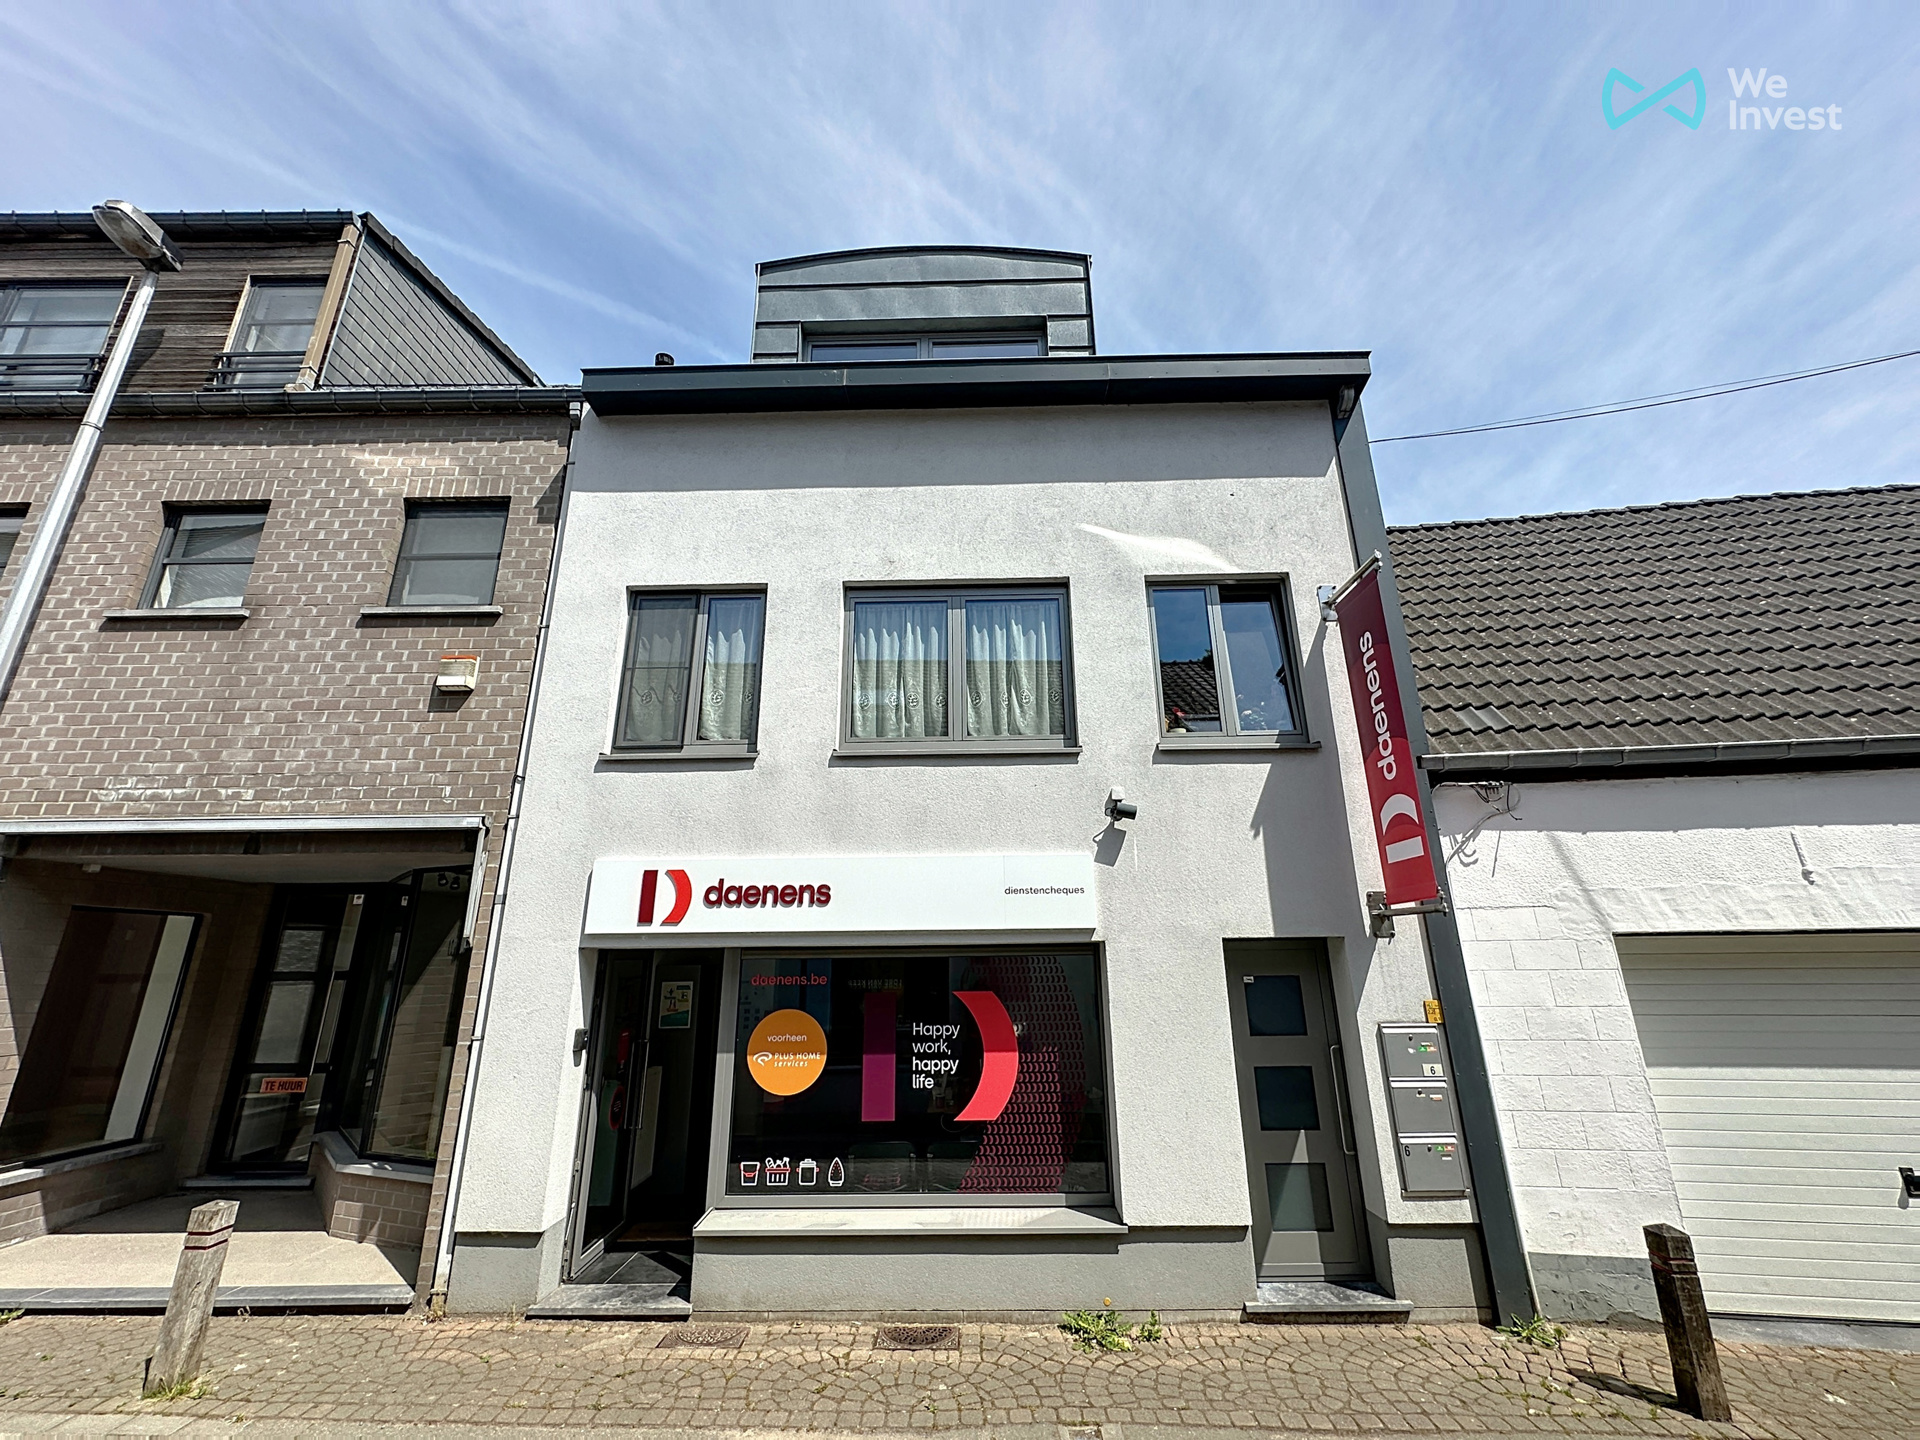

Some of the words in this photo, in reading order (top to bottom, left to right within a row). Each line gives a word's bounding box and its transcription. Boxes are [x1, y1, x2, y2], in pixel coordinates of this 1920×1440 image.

[1359, 630, 1397, 781] daenens
[703, 878, 832, 908] daenens
[1004, 885, 1085, 896] dienstencheques
[751, 973, 828, 986] daenens.be
[767, 1033, 807, 1042] voorheen
[912, 1022, 961, 1040] Happy
[912, 1039, 952, 1056] work,
[774, 1052, 794, 1060] PLUS
[796, 1052, 821, 1060] HOME
[912, 1056, 960, 1075] happy
[1430, 1066, 1436, 1075] 6
[265, 1081, 276, 1091] TE
[278, 1081, 303, 1091] HUUR
[912, 1073, 934, 1089] life
[1404, 1145, 1410, 1157] 6
